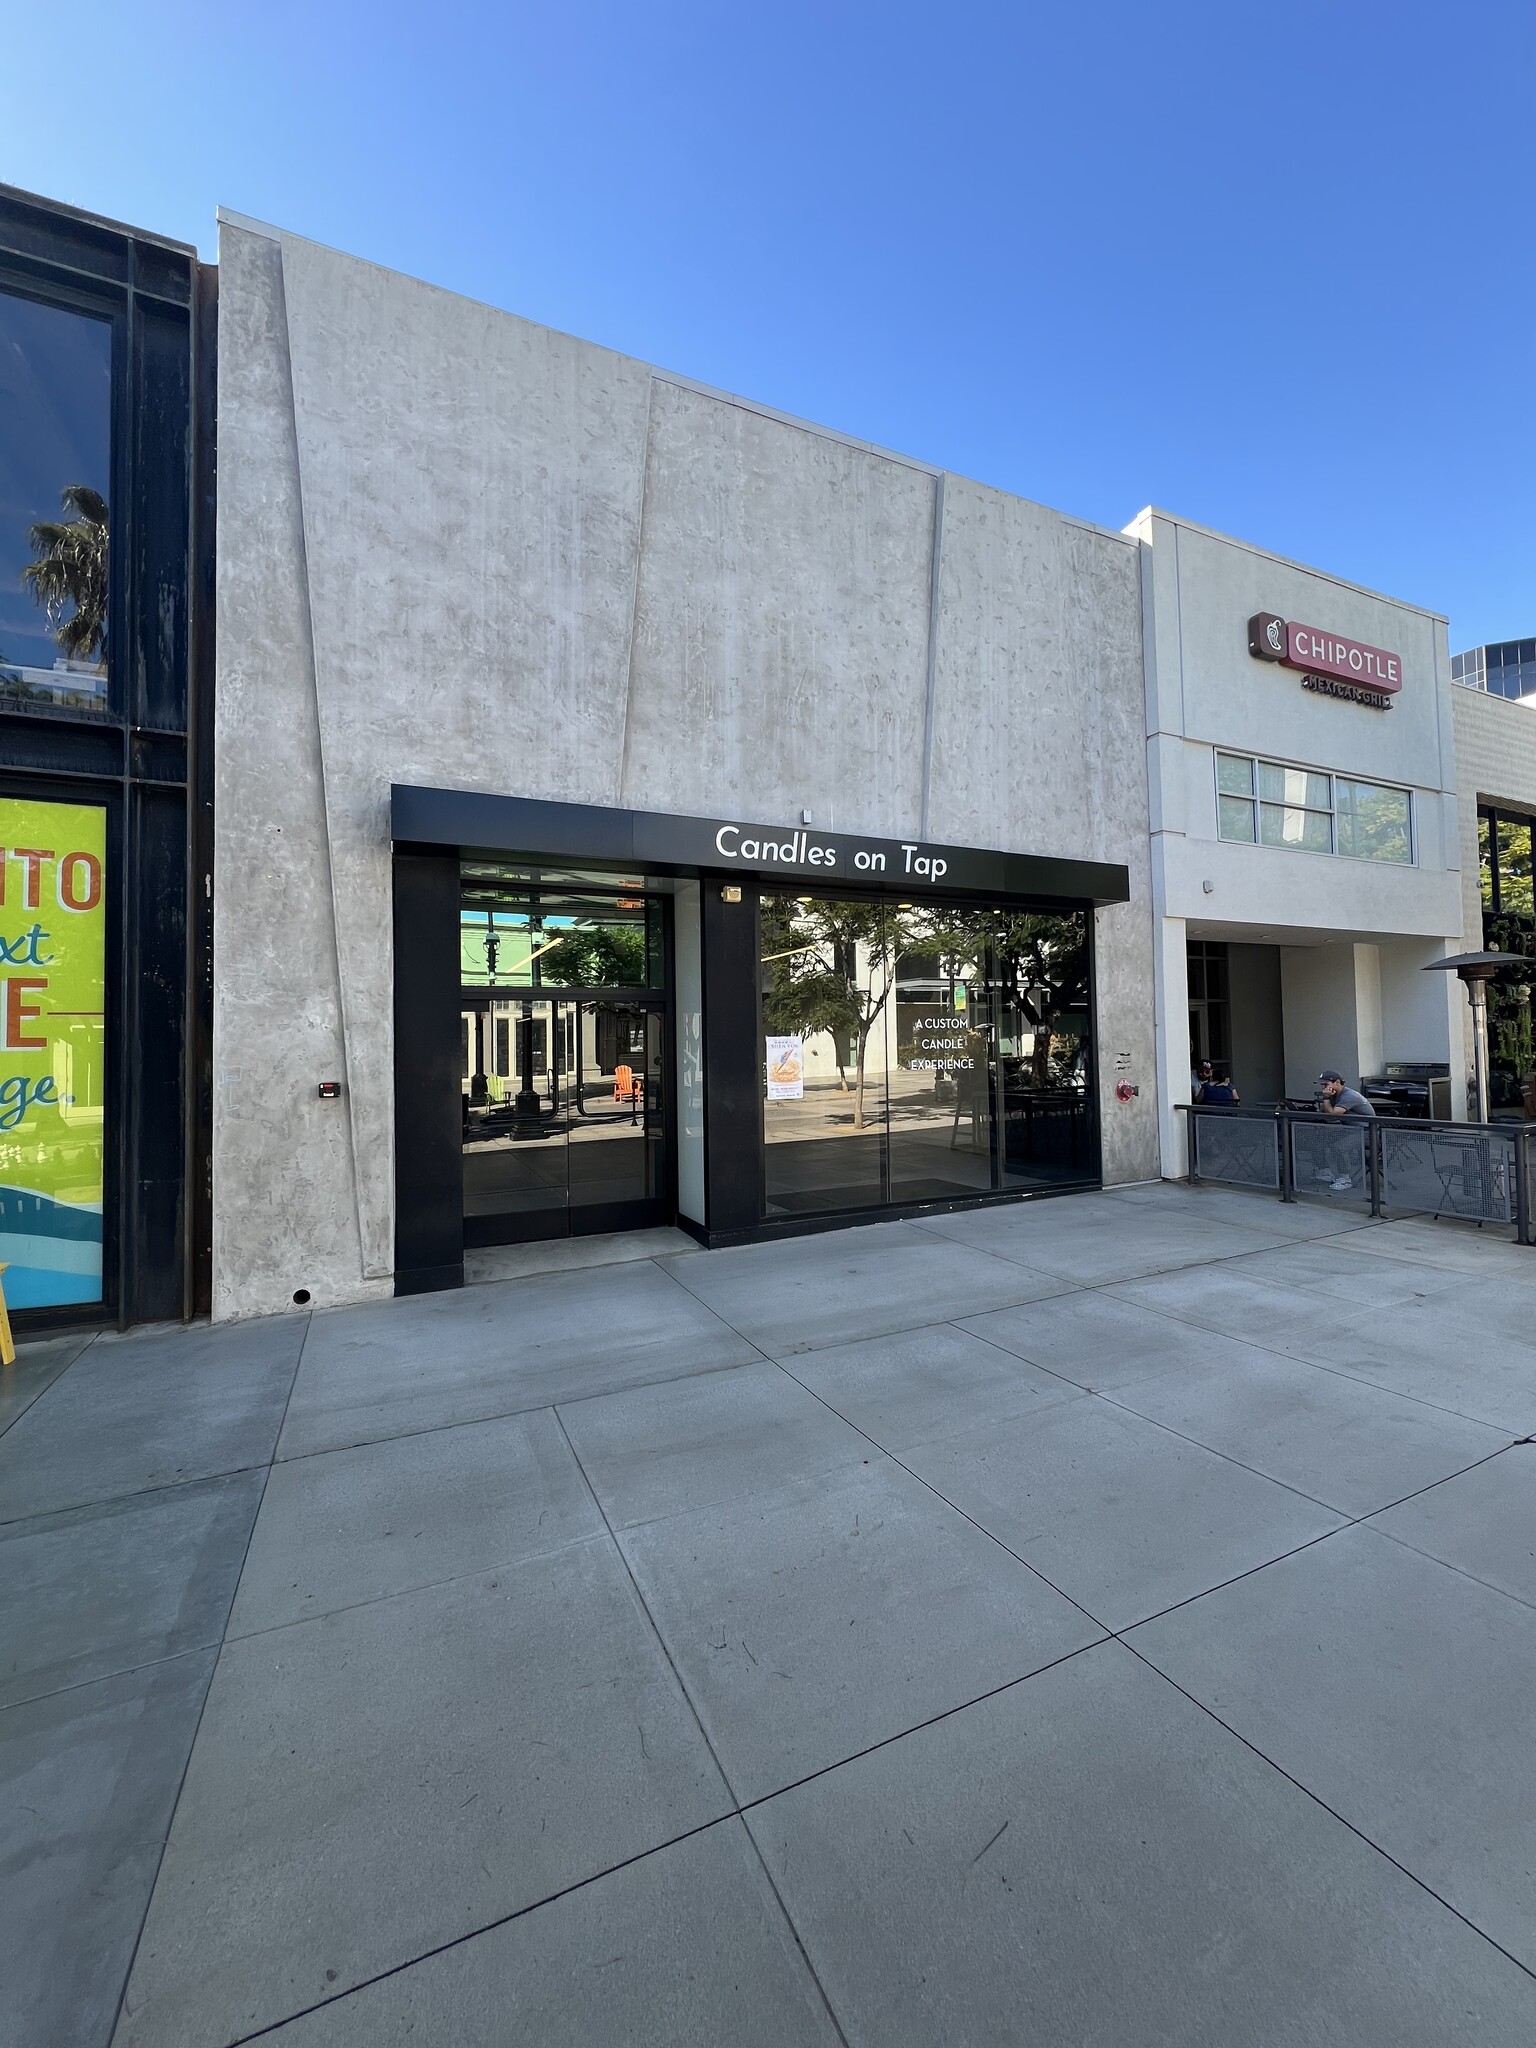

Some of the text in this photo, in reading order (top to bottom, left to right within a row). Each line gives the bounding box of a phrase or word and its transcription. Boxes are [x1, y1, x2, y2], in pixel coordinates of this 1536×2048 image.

[1295, 631, 1398, 682] CHIPOTLE
[1308, 675, 1360, 701] MEXICAN
[715, 826, 947, 882] Candles on Tap
[915, 1018, 968, 1029] A CUSTOM
[921, 1038, 964, 1050] CANDLE
[910, 1058, 975, 1070] EXPERIENCE
